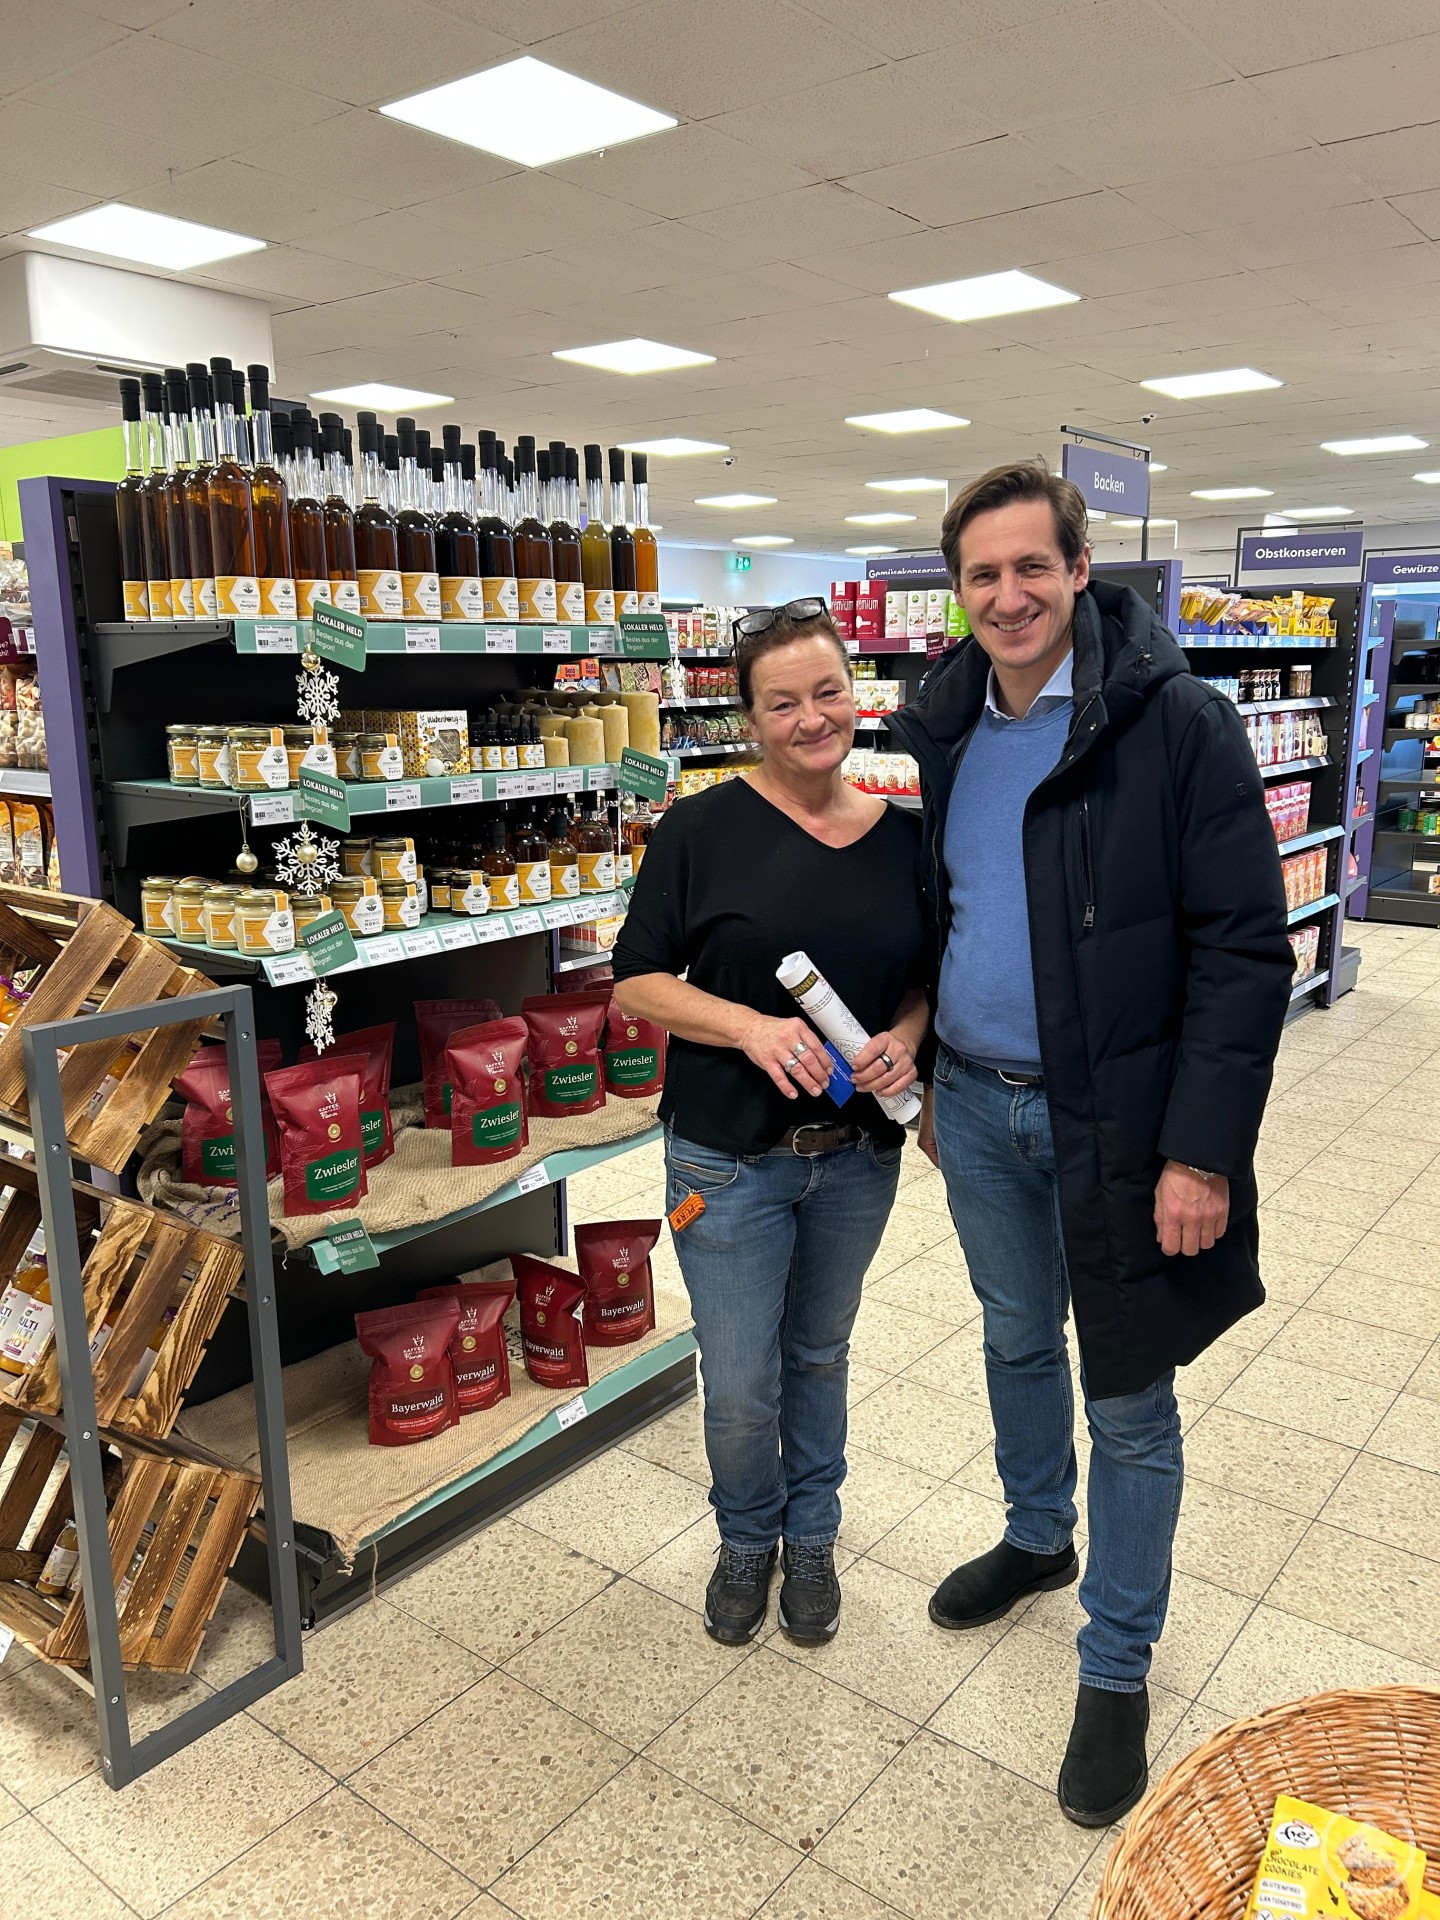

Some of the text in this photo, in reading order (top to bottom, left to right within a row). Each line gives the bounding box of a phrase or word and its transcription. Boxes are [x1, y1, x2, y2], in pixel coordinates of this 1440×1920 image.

[1093, 471, 1125, 494] Backen
[1255, 547, 1346, 560] Obstkonserven
[1392, 564, 1440, 575] Gewürze
[316, 613, 363, 638] LOKALER HELD
[623, 623, 648, 631] LOKALER
[315, 638, 336, 652] Region!
[316, 628, 356, 650] Bestes aus der
[625, 635, 641, 643] Bestes
[625, 756, 665, 777] LOKALER HELD
[623, 768, 657, 786] Bestes aus der
[303, 778, 344, 800] LOKALER HELD
[304, 793, 340, 811] Bestes aus der
[306, 921, 345, 945] LOKALER HELD
[327, 943, 336, 952] aus
[335, 939, 344, 949] der
[613, 1055, 654, 1068] Zwiesler
[552, 1072, 594, 1086] Zwiesler
[480, 1109, 520, 1130] Zwiesler
[314, 1157, 358, 1181] Zwiesler
[333, 1229, 365, 1245] LOKALER HELD
[601, 1298, 645, 1318] Bayerwald
[456, 1364, 496, 1385] yerwald
[391, 1392, 444, 1415] Bayerwald
[1264, 1864, 1304, 1880] COOKIES
[1266, 1856, 1320, 1877] CHOCOLATE
